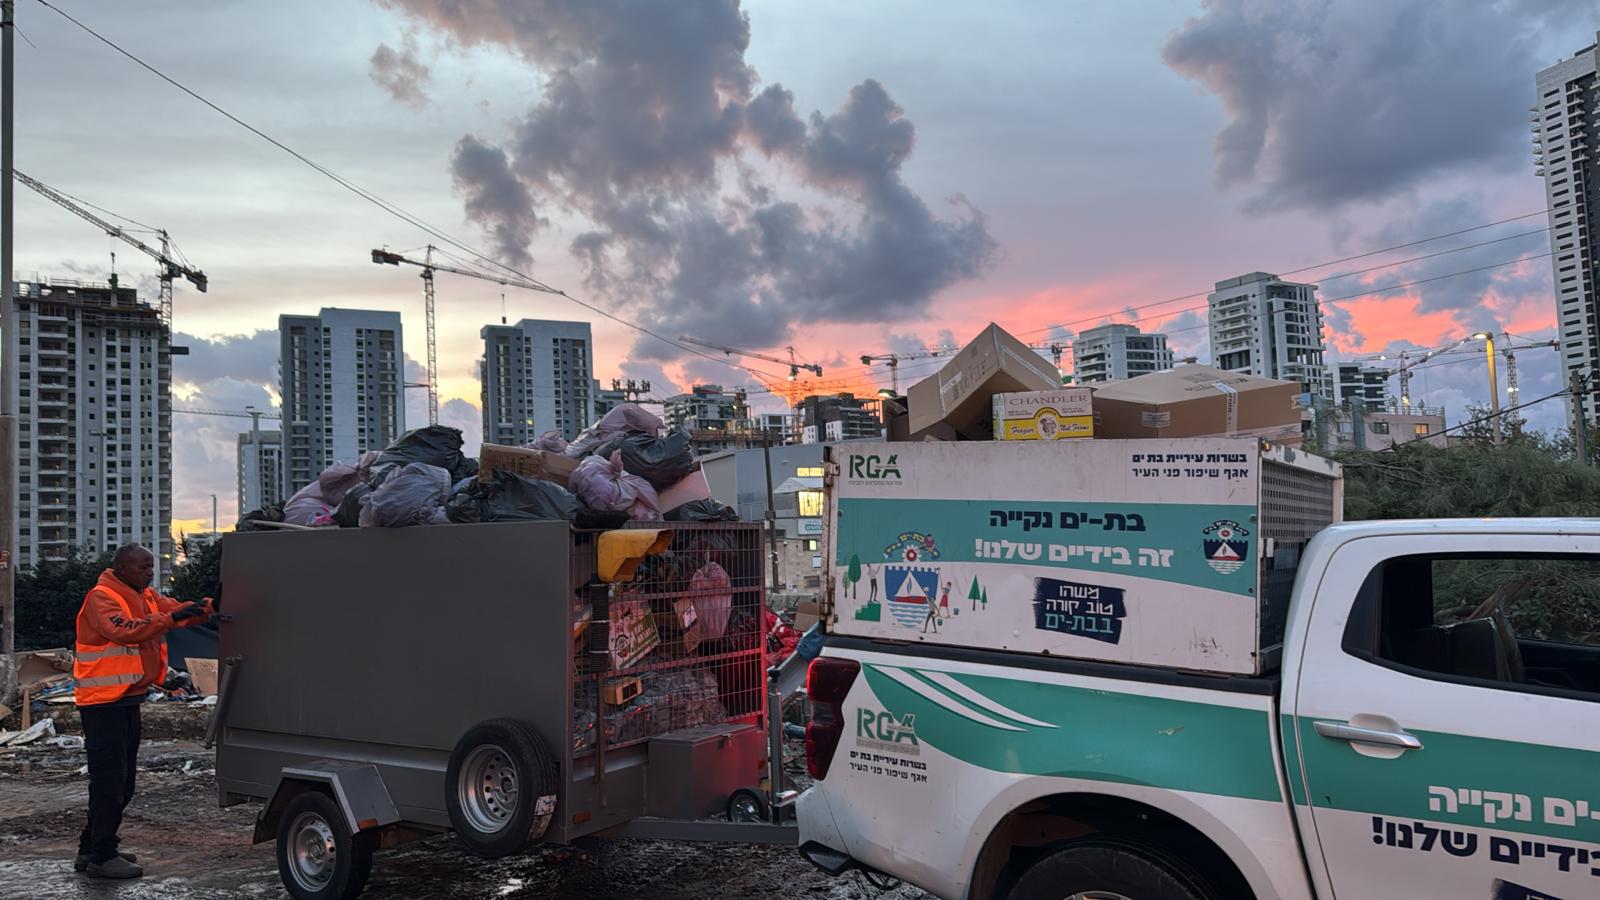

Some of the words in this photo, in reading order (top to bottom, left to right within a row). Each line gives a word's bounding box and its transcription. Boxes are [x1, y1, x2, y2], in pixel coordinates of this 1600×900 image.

[1009, 395, 1087, 406] CHANDLER
[1132, 454, 1145, 463] ים
[1147, 454, 1164, 463] בת
[1166, 453, 1204, 463] עיריית
[1206, 453, 1248, 463] בשרות
[849, 454, 902, 479] RGA
[1132, 468, 1159, 478] העיר
[1163, 468, 1180, 478] פני
[1184, 468, 1220, 478] שיפור
[1223, 468, 1249, 480] אגף
[990, 510, 1053, 532] נקייה
[1060, 511, 1146, 532] בת-ים
[975, 538, 1042, 561] שלנו!
[1048, 543, 1132, 566] בידיים
[1138, 548, 1174, 567] זה
[1059, 585, 1099, 600] משהו
[1046, 599, 1080, 615] קורה
[1085, 601, 1113, 615] טוב
[1045, 613, 1114, 634] בבת-ים
[857, 708, 918, 746] RGA
[850, 750, 859, 758] ים
[860, 752, 872, 761] בת
[872, 754, 898, 765] עיריית
[849, 762, 869, 772] העיר
[900, 758, 927, 770] בשרות
[870, 765, 883, 775] פני
[884, 768, 908, 779] שיפור
[910, 772, 928, 783] אגף
[1428, 785, 1532, 824] נקייה
[1372, 816, 1478, 857] שלנו!
